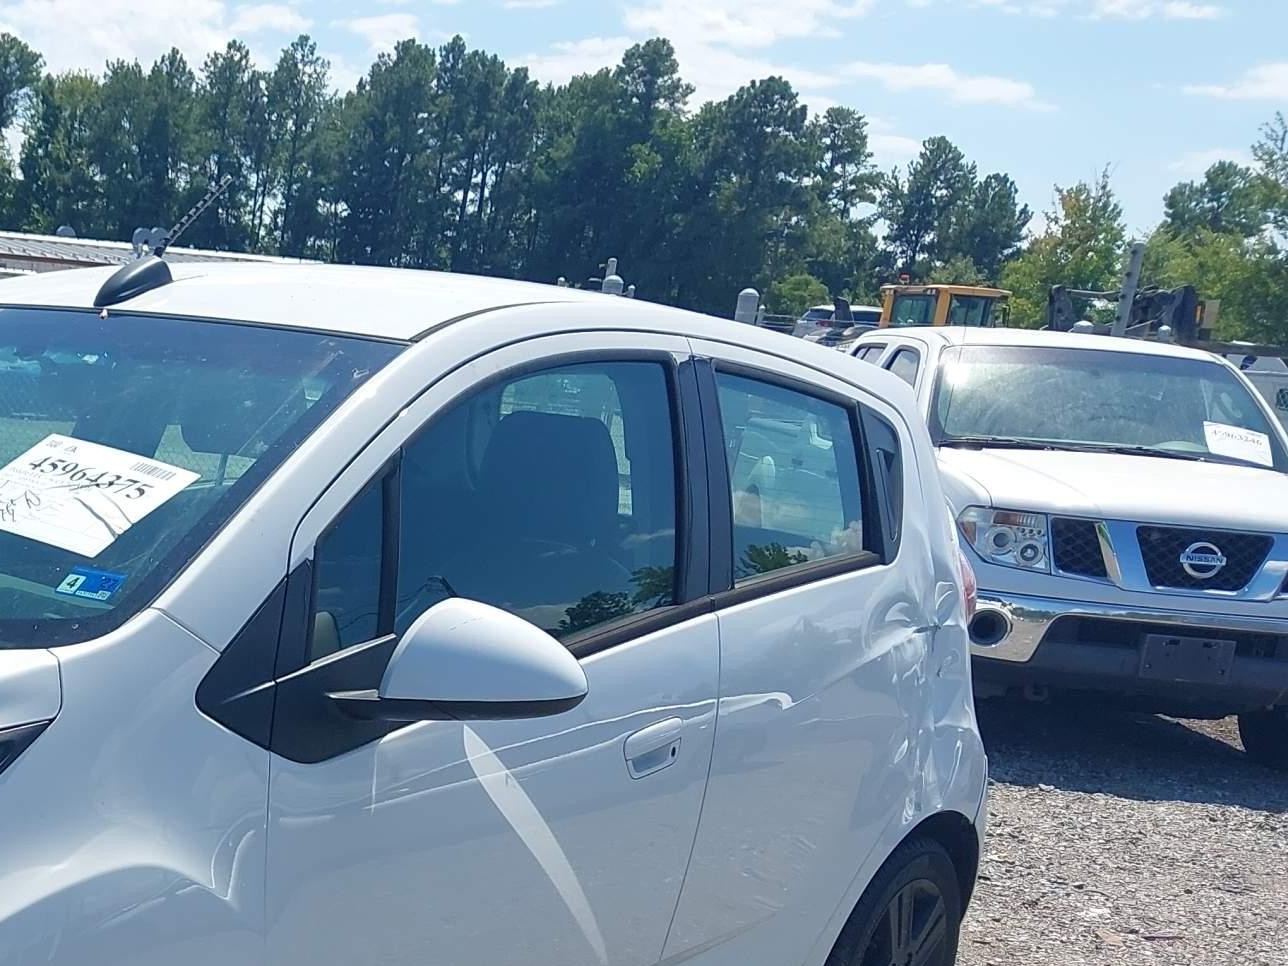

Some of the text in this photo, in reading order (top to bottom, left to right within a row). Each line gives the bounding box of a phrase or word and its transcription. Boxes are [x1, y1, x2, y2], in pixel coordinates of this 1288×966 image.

[29, 456, 154, 499] 45964375
[1185, 554, 1224, 564] NISSAN
[67, 577, 80, 589] 4
